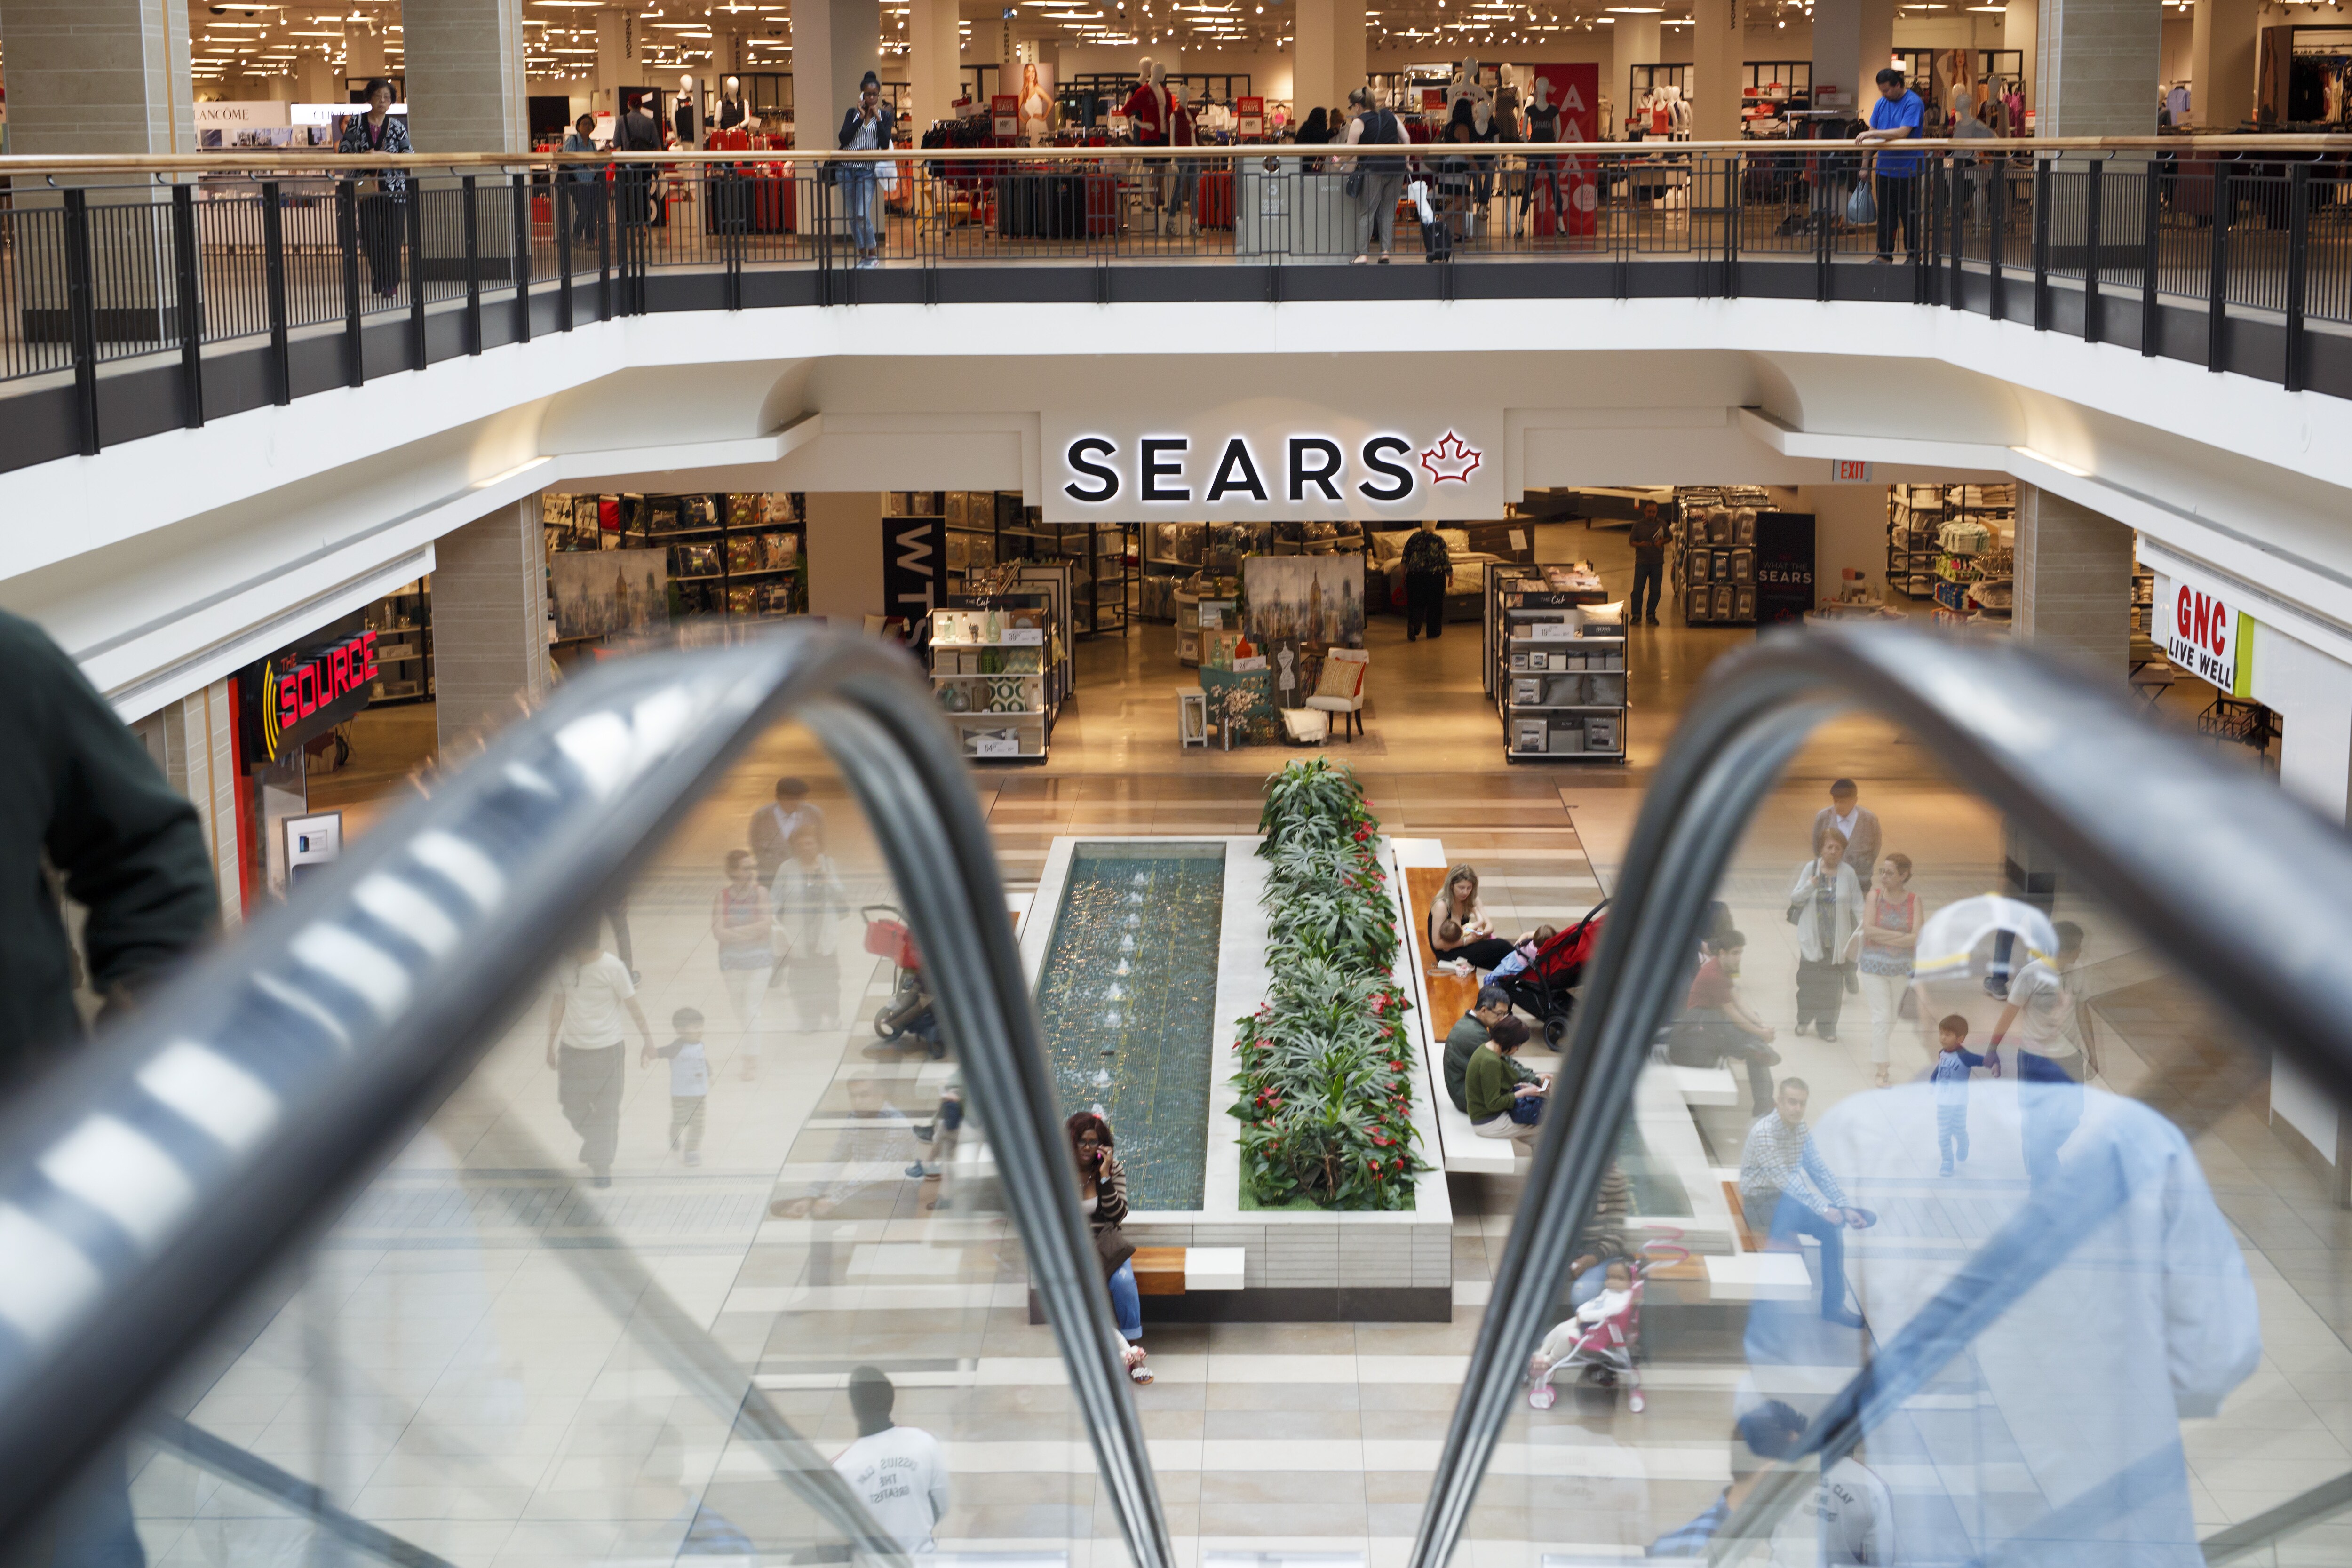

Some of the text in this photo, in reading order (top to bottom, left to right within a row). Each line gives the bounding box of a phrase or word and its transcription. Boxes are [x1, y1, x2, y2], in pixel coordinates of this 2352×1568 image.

[1064, 436, 1414, 501] SEARS
[1841, 461, 1866, 480] EXIT
[1758, 569, 1812, 584] SEARS
[1763, 561, 1808, 571] WHAT THE
[2177, 584, 2225, 656] GNC
[280, 652, 298, 673] THE
[2169, 636, 2231, 689] LIVE WELL
[280, 631, 379, 730] SOURCE
[1833, 1483, 1854, 1504] CLAY
